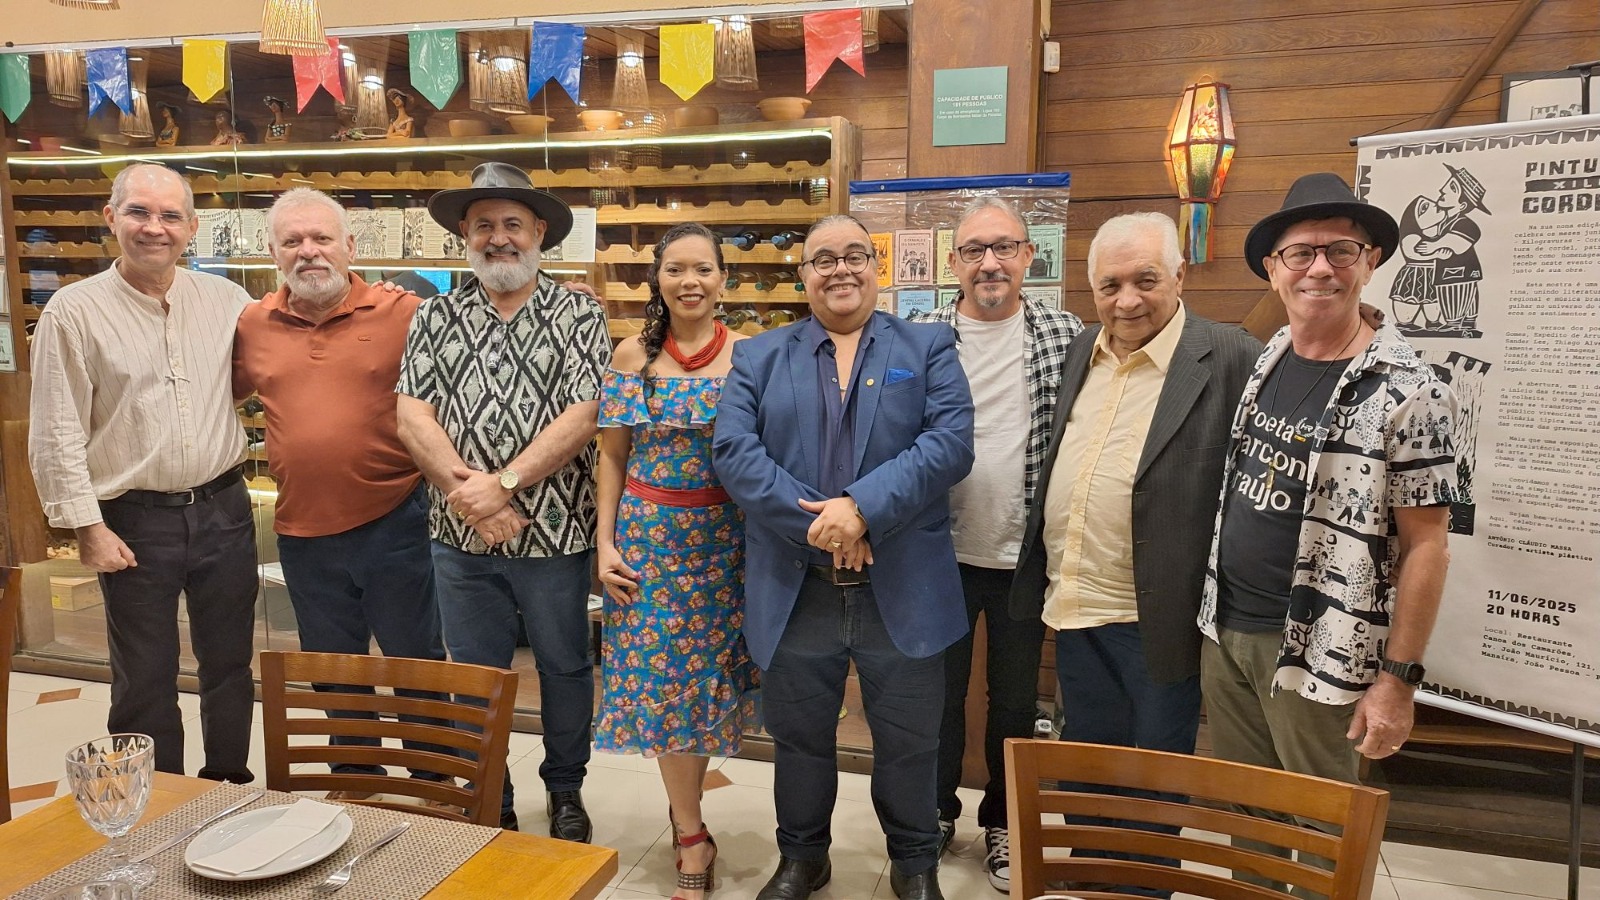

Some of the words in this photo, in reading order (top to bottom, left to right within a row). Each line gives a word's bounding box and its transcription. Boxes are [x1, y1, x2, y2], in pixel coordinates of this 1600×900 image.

[1526, 158, 1598, 177] PINTU
[1553, 179, 1600, 190] XIL
[1241, 434, 1306, 480] arcon
[1530, 466, 1571, 474] testemunho
[1232, 470, 1291, 510] raújo
[1509, 477, 1549, 485] Convidamos
[1529, 486, 1577, 495] simplicidade
[1488, 535, 1515, 543] ANTÔNIO
[1519, 539, 1547, 548] CLÁUDIO
[1488, 542, 1514, 550] Curador
[1559, 553, 1592, 561] plástico
[1488, 590, 1576, 613] 11/06/2025
[1487, 604, 1504, 615] 20
[1511, 609, 1560, 626] HORAS
[1483, 635, 1507, 643] Canoa
[1531, 644, 1575, 658] Camarões,
[1485, 627, 1512, 636] Local:
[1518, 633, 1572, 648] Restaurante
[1481, 651, 1518, 663] Manaíra,
[1524, 660, 1544, 668] João
[1550, 665, 1579, 675] Pessoa
[1525, 652, 1569, 666] Maurício,
